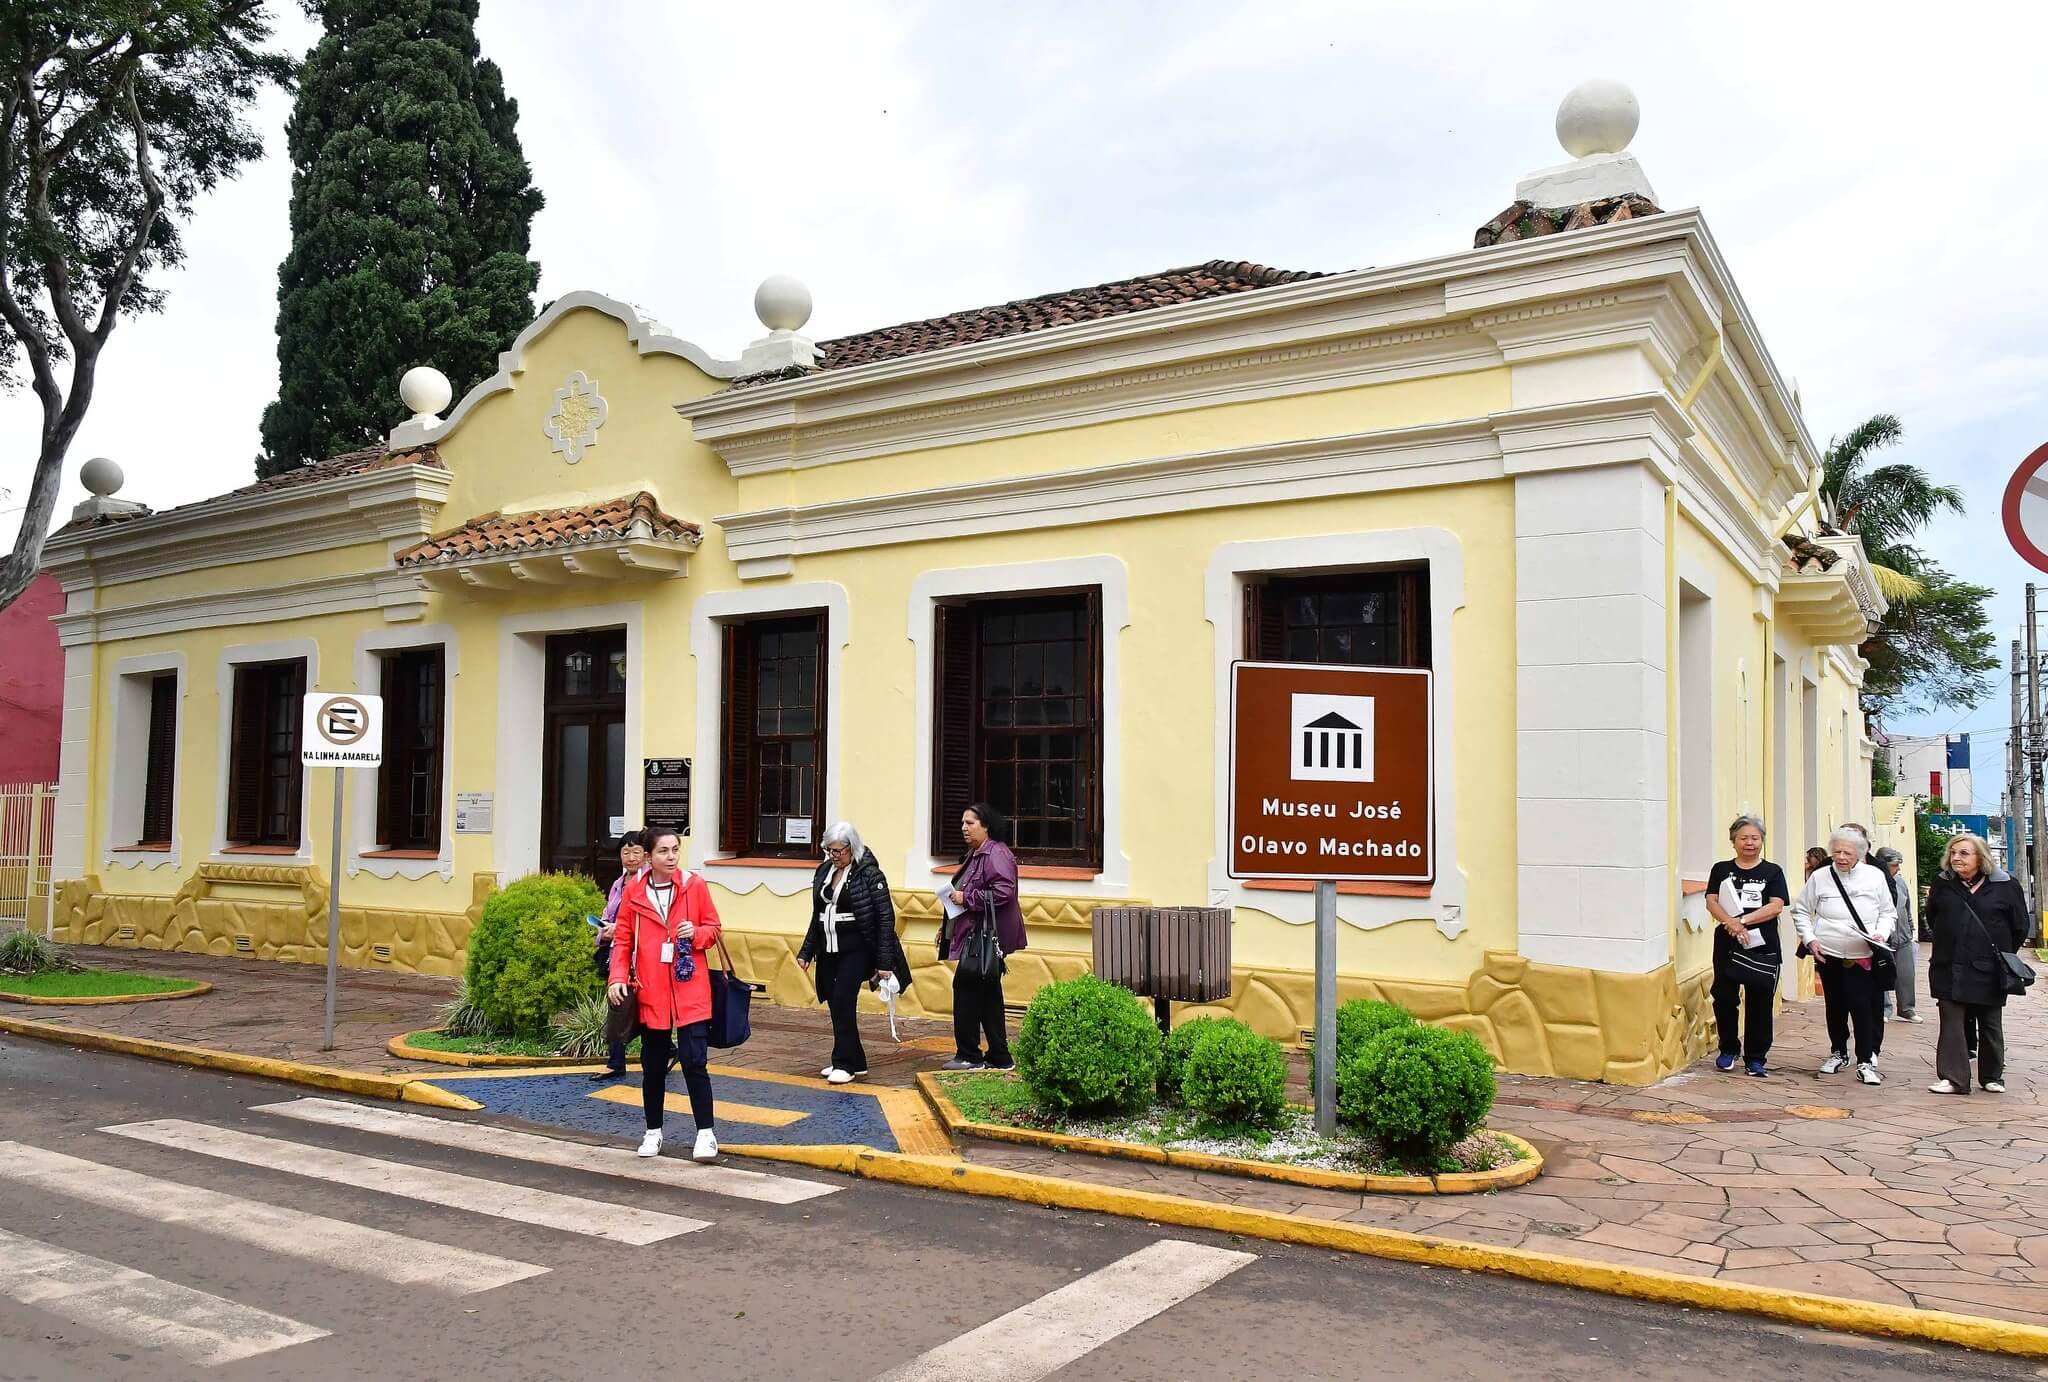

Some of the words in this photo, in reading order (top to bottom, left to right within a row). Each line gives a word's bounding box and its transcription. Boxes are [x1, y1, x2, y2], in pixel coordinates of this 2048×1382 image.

[303, 751, 314, 760] NA
[315, 752, 341, 761] LINHA
[342, 752, 381, 762] AMARELA
[1262, 798, 1337, 818] Museu
[1349, 800, 1402, 819] José
[1241, 835, 1308, 855] Olavo
[1319, 837, 1422, 857] Machado
